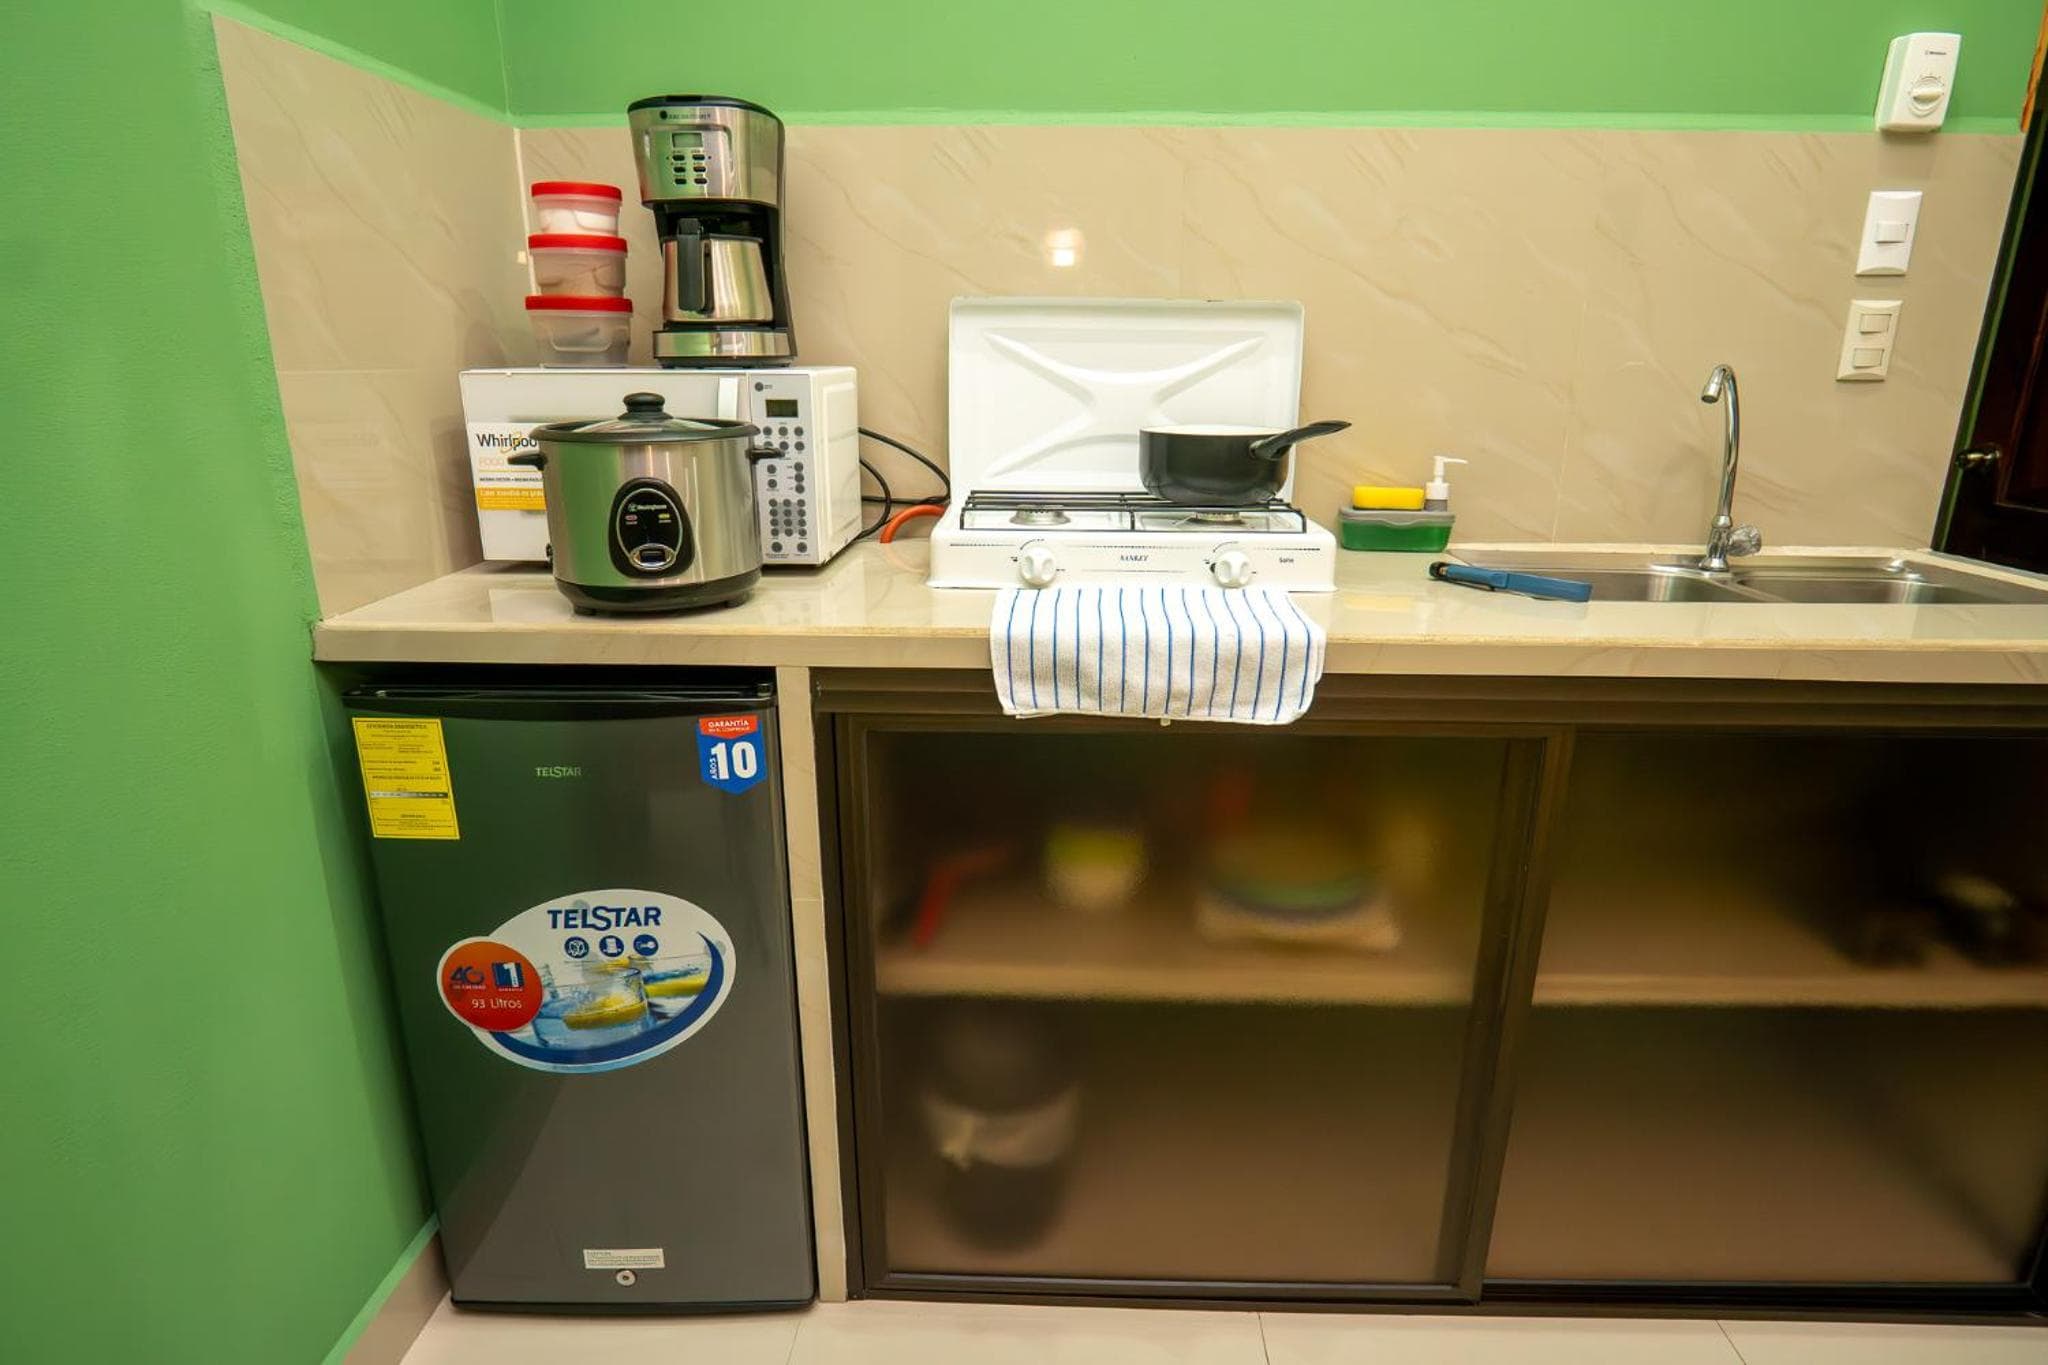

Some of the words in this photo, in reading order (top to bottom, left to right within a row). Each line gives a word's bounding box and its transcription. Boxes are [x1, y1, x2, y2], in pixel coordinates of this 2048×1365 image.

[476, 433, 538, 451] Whirlpoo
[711, 741, 757, 779] 10
[534, 766, 582, 778] TELSTAR
[547, 906, 662, 931] TELSTAR
[472, 999, 486, 1009] 93
[491, 997, 523, 1009] Litros
